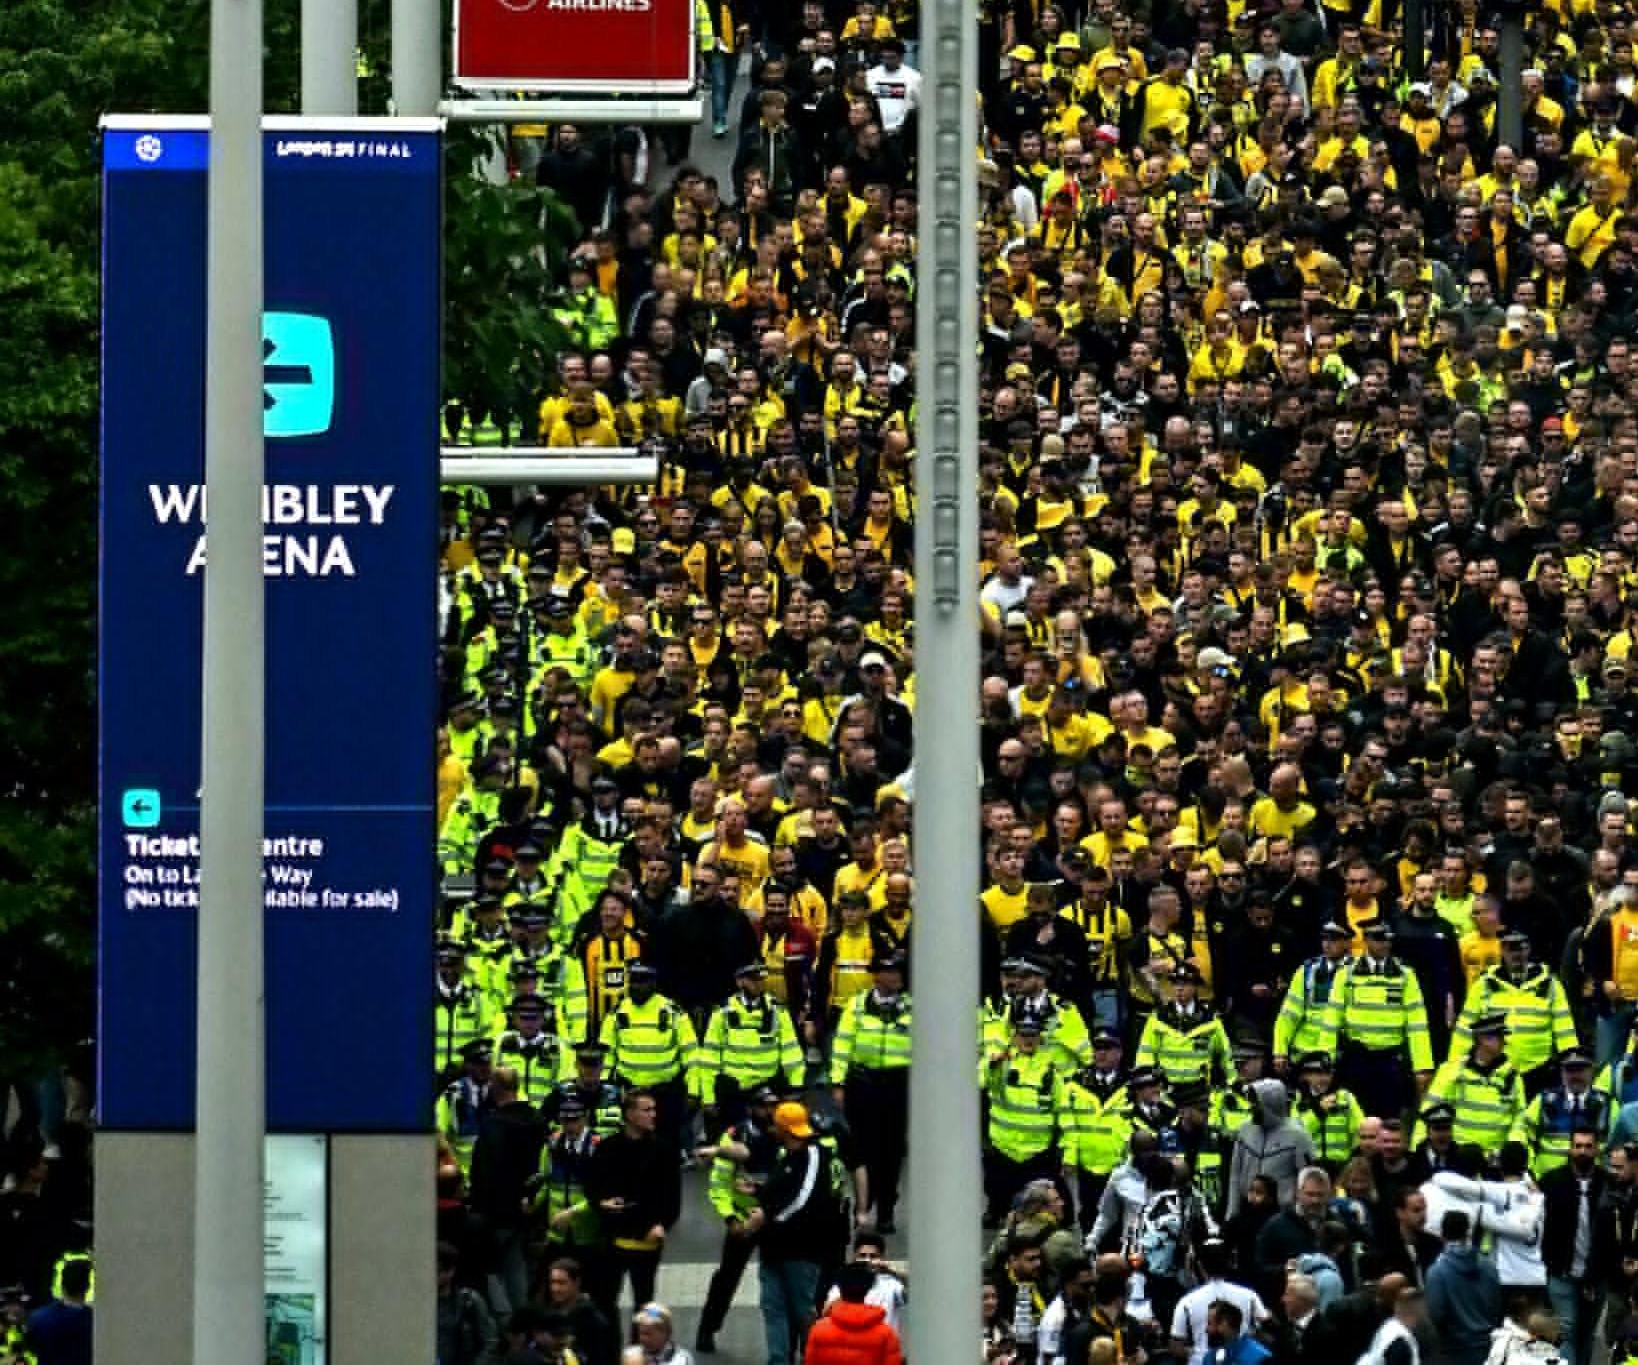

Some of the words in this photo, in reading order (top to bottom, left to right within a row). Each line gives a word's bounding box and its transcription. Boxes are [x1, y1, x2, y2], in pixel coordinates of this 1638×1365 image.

[149, 484, 397, 524] WBLEY
[184, 535, 356, 576] AENA
[125, 834, 200, 857] Ticket
[263, 836, 323, 857] entre
[271, 864, 313, 889] Way
[163, 889, 200, 908] tick
